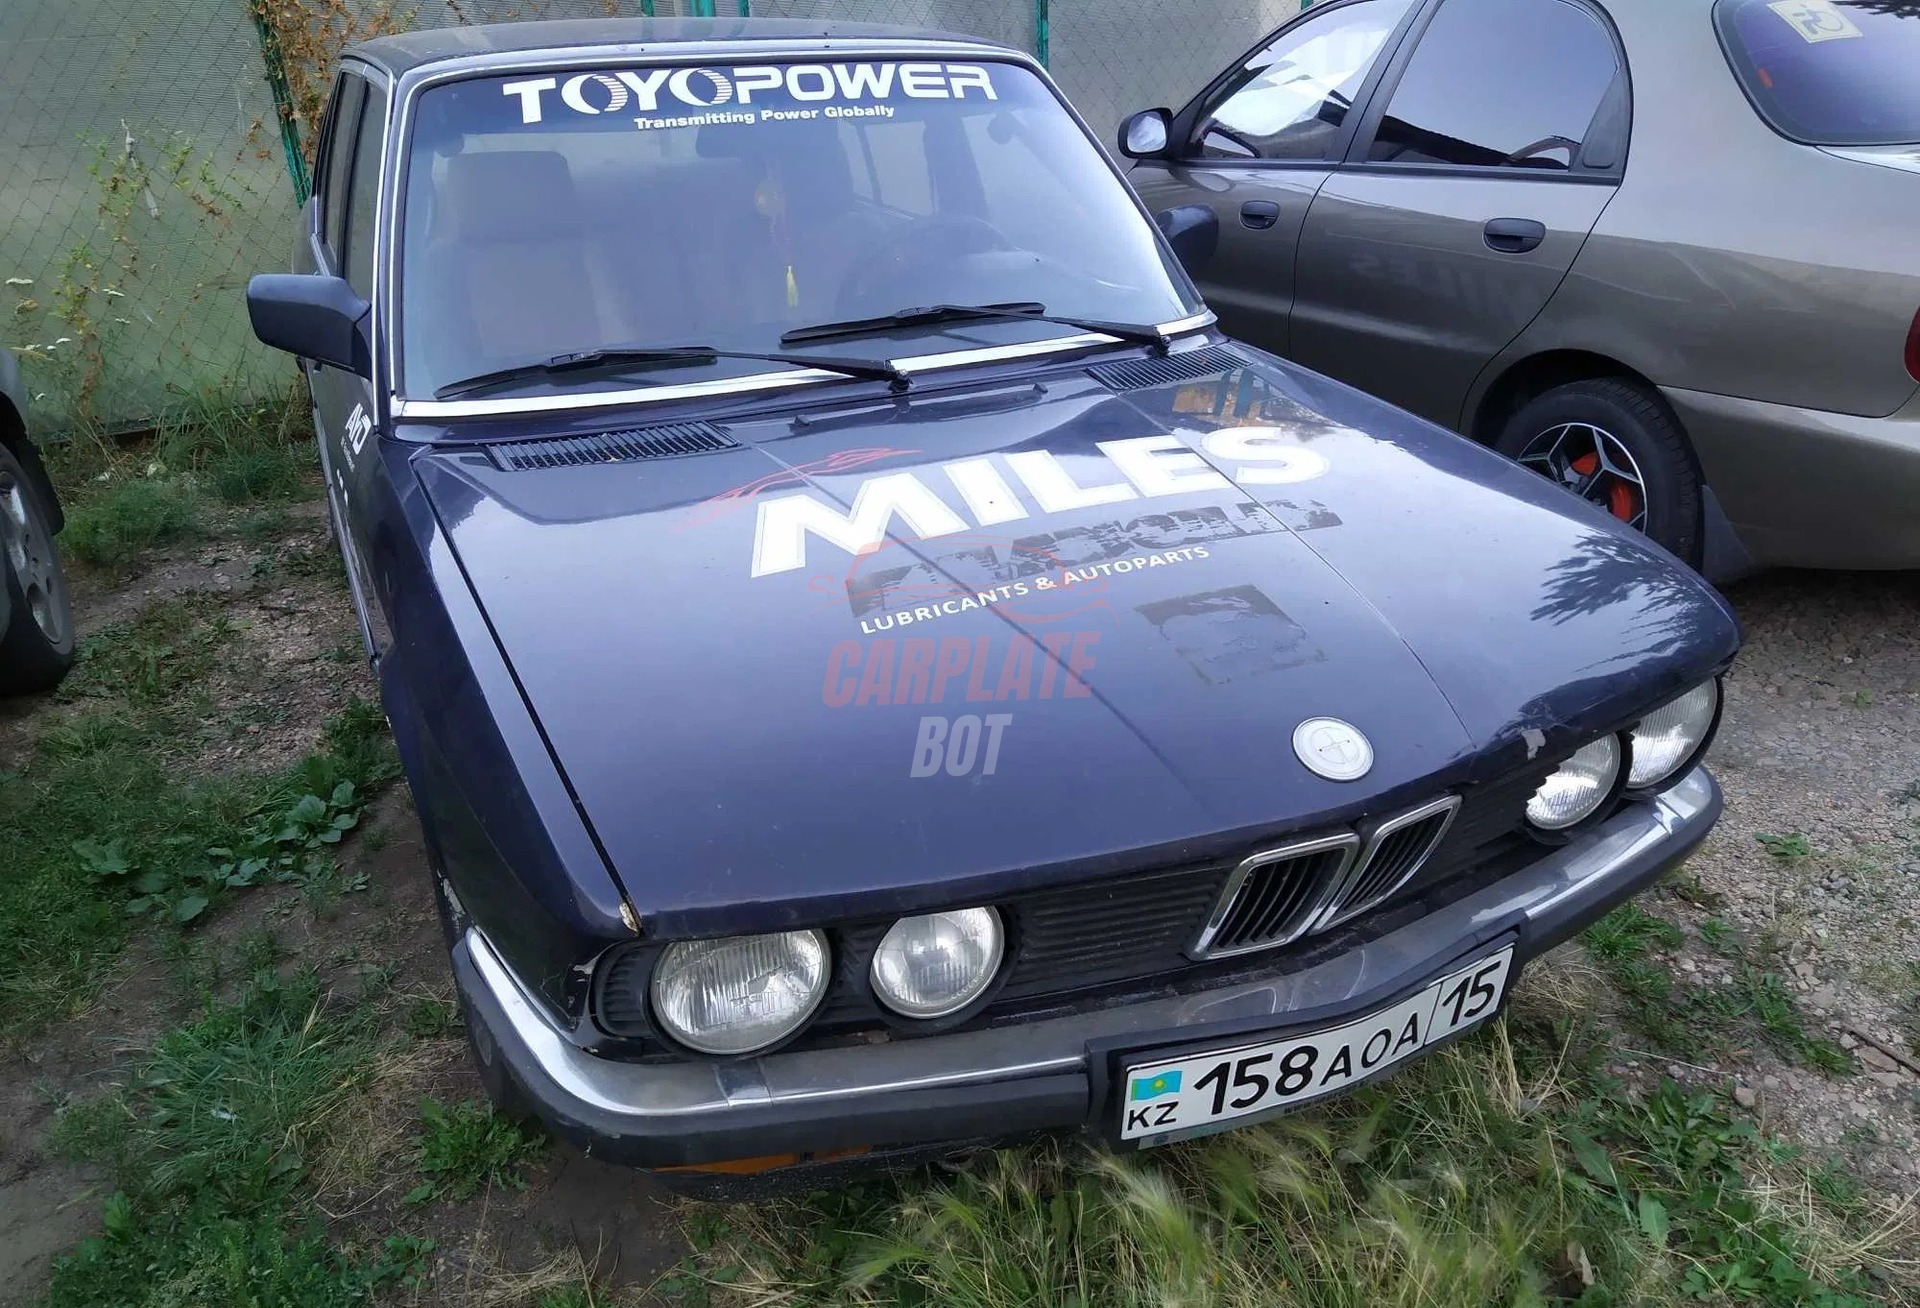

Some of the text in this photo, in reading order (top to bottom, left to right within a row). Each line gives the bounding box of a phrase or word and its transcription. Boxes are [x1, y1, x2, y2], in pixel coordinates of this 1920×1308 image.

[502, 63, 998, 124] TOYOPOWER
[634, 105, 894, 130] Transmitting Power Globally
[750, 426, 1331, 579] MILES
[860, 546, 1211, 635] LUBRICANTS & AUTOPARTS
[1442, 960, 1501, 1027] 15
[1127, 1101, 1179, 1131] KZ
